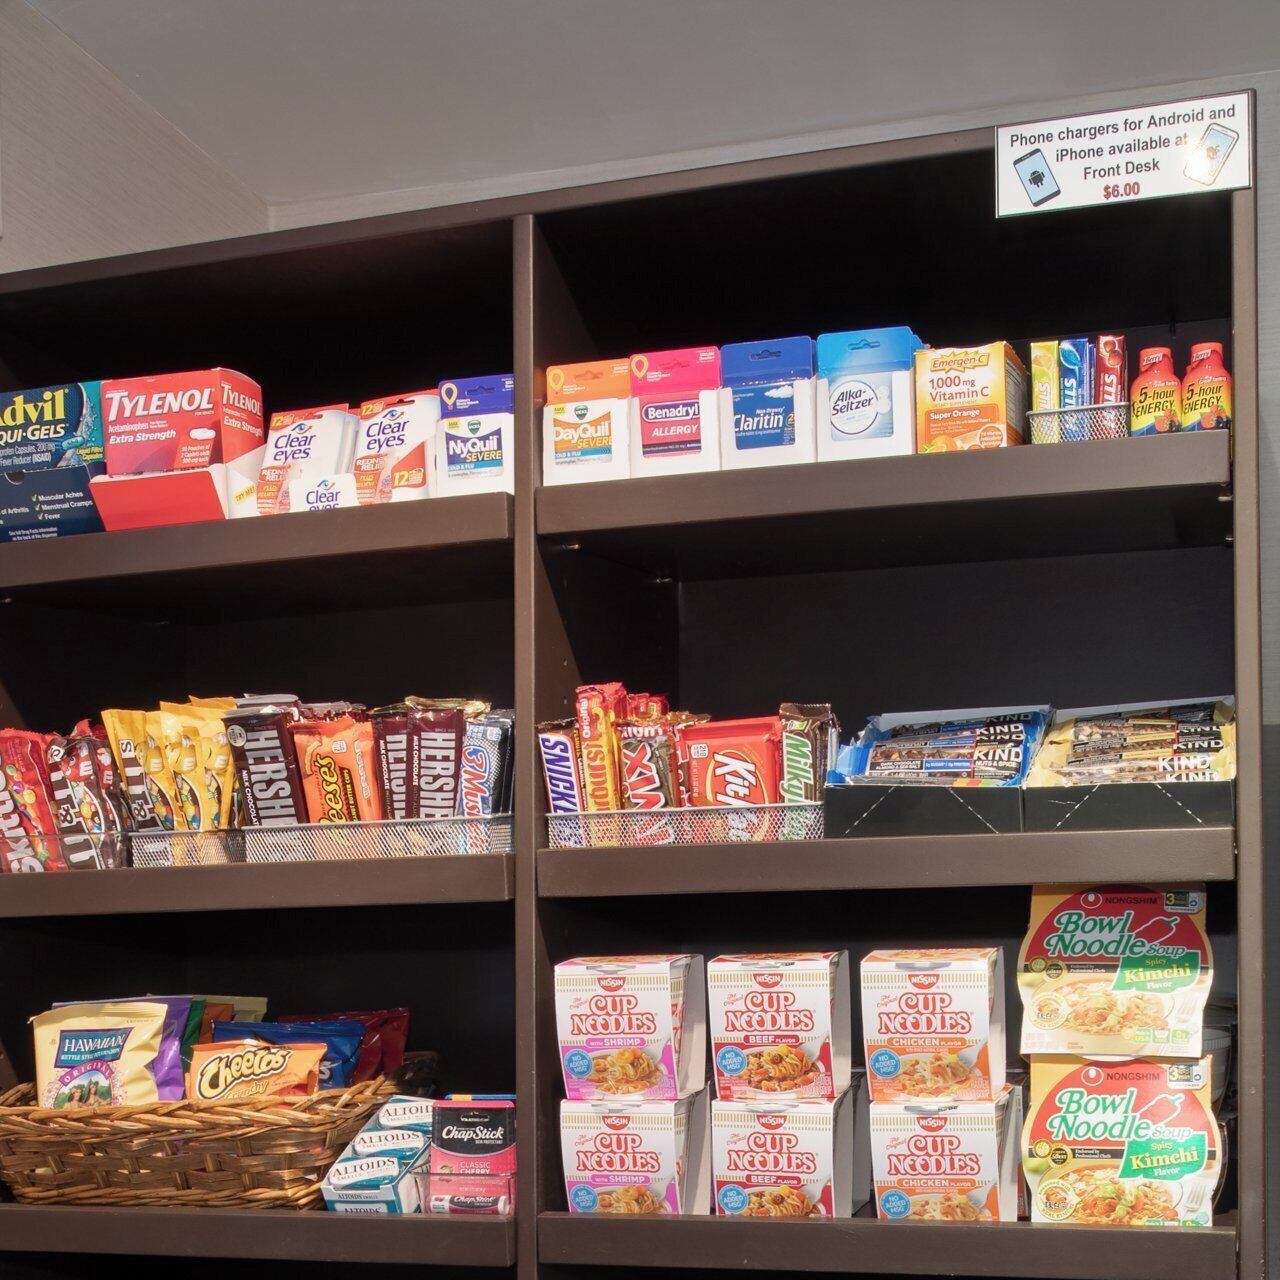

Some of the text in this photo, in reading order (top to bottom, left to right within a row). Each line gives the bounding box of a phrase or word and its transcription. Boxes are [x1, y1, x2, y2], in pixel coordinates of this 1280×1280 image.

[1010, 104, 1236, 148] Phone chargers for Android and
[1056, 132, 1188, 162] iPhone available at
[1083, 158, 1160, 180] Front Desk
[1103, 181, 1140, 200] $6.00
[932, 353, 987, 370] Emergen-C
[928, 375, 976, 391] 1,000 mg
[835, 389, 866, 405] Alka-
[930, 386, 989, 403] Vitamin C
[1139, 387, 1175, 402] 5-hour
[105, 387, 215, 422] TYLENOL
[647, 403, 699, 420] Benadryl
[831, 396, 874, 416] Seltzer
[1135, 401, 1175, 416] ENERGY
[930, 408, 980, 420] Super Orange
[366, 419, 409, 438] Clear
[651, 424, 699, 438] ALLERGY
[109, 429, 176, 446] Extra Strength
[274, 432, 316, 450] Clear
[366, 436, 404, 452] eyes
[273, 447, 310, 464] eyes
[448, 436, 498, 458] NyQuil
[466, 449, 502, 462] SEVERE
[973, 747, 1023, 762] KIND
[1159, 755, 1210, 771] KIND
[1055, 911, 1134, 936] Bowl
[1044, 934, 1187, 957] Noodle Soup
[600, 978, 624, 988] NISSIN
[1124, 965, 1192, 984] Kimchi
[589, 995, 638, 1014] CUP
[744, 991, 795, 1010] CUP
[570, 1012, 656, 1036] NOODLES
[724, 1010, 814, 1032] NOODLES
[64, 1034, 126, 1052] HAWAIIAN
[604, 1038, 640, 1046] SHRIMP
[892, 1037, 940, 1046] CHICKEN
[197, 1048, 290, 1098] Cheetos
[1106, 1072, 1160, 1081] NONGSHIM
[1057, 1089, 1137, 1115] Bowl
[442, 1125, 504, 1142] ChapStick
[1046, 1115, 1192, 1140] Noodle Soup
[1150, 1141, 1173, 1151] Spicy
[332, 1158, 395, 1177] ALTOIDS
[1129, 1148, 1199, 1170] Kimchi
[1153, 1166, 1180, 1177] Flavor
